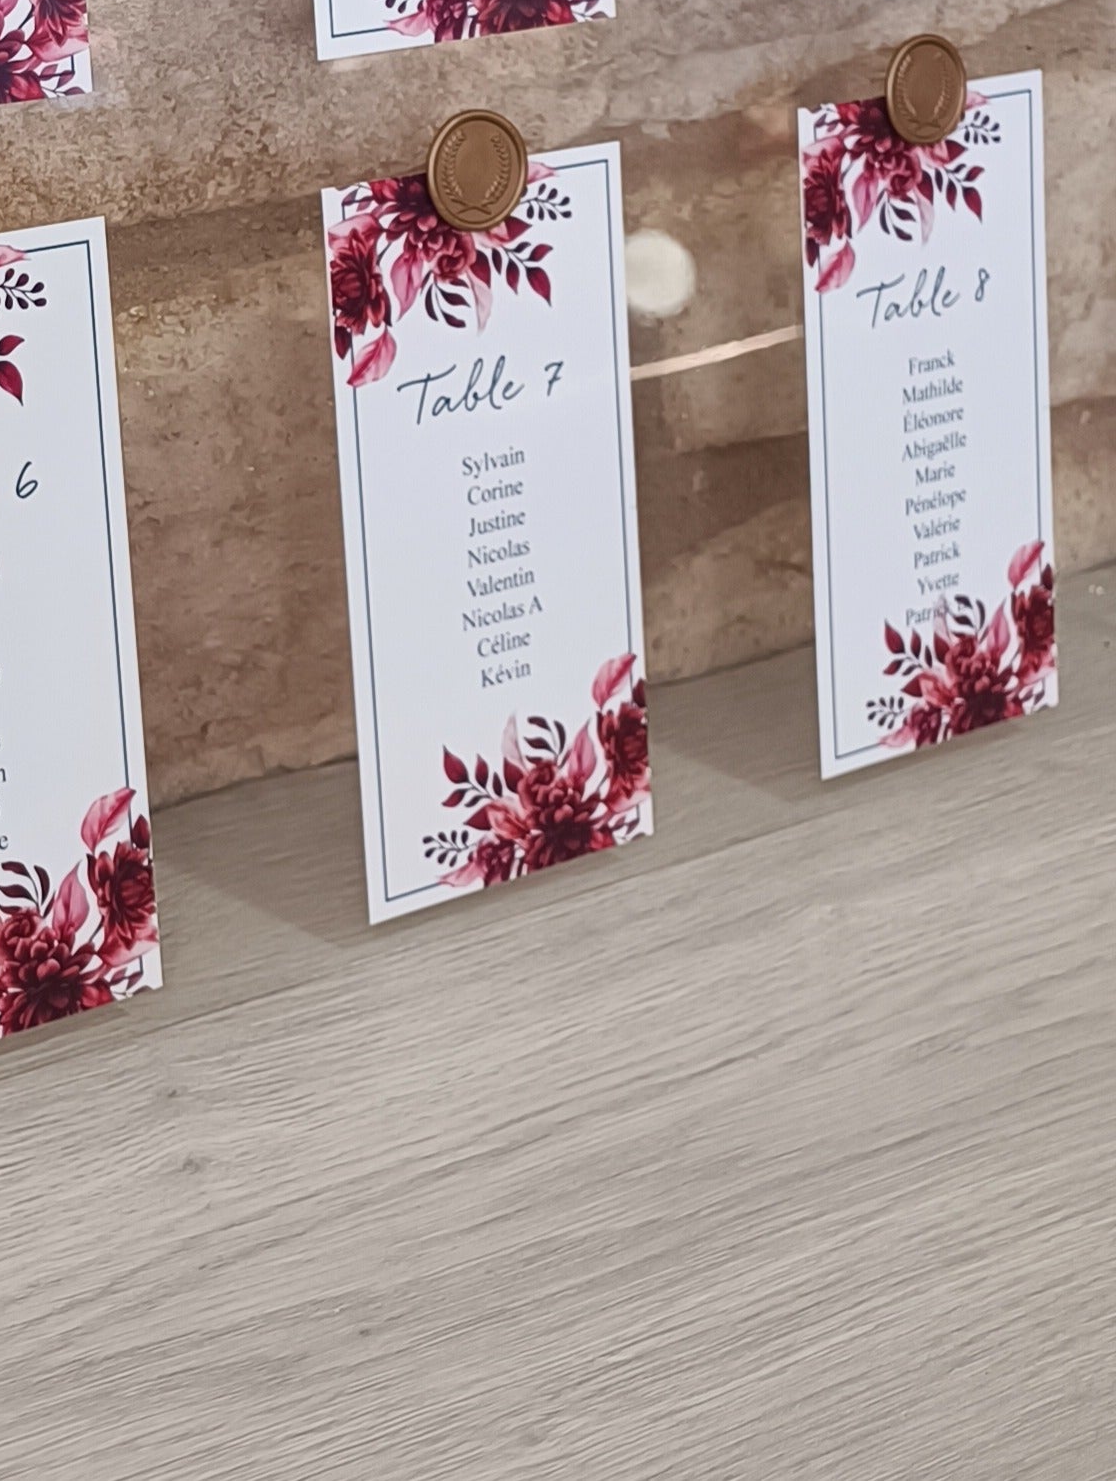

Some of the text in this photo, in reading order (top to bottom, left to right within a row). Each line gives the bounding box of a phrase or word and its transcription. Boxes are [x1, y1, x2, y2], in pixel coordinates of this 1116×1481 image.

[856, 265, 990, 329] Table 8
[909, 350, 955, 376] Franck
[397, 355, 564, 425] Table 7
[903, 377, 963, 404] Mathilde
[903, 408, 964, 433] Éléonore
[902, 431, 967, 461] Abigaëlle
[462, 447, 524, 479] Sylvain
[916, 462, 955, 485] Marie
[15, 461, 38, 499] 6
[467, 479, 523, 506] Corine
[906, 490, 966, 517] Pénélope
[469, 510, 526, 537] Justine
[913, 518, 960, 540] Valérie
[468, 539, 530, 568] Nicolas
[914, 542, 960, 569] Patrick
[467, 567, 535, 597] Valentin
[462, 595, 543, 631] Nicolas A
[477, 631, 530, 658] Céline
[481, 663, 531, 688] Kévin
